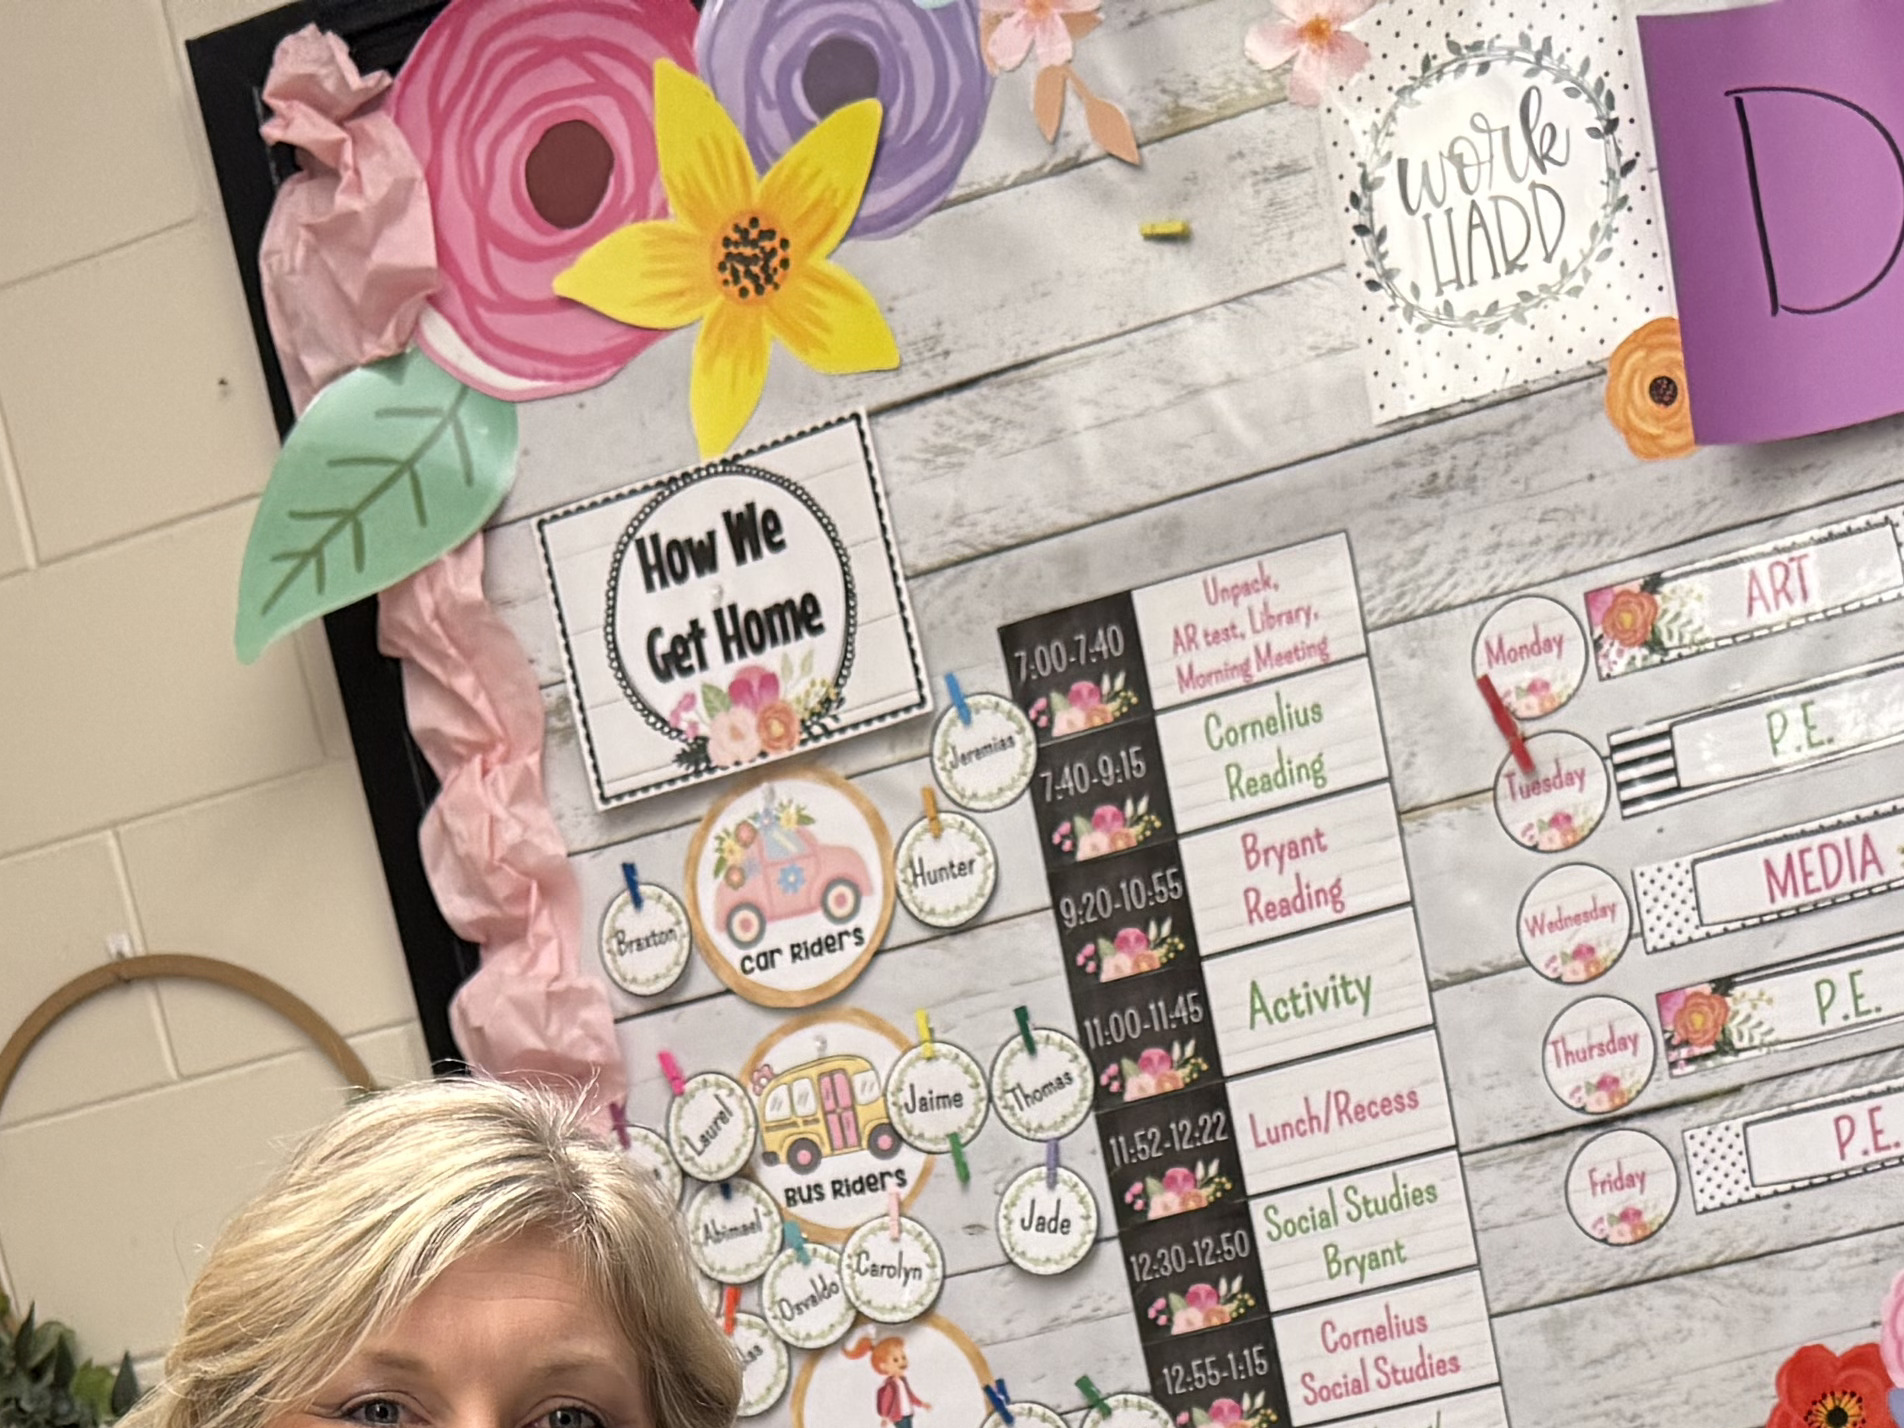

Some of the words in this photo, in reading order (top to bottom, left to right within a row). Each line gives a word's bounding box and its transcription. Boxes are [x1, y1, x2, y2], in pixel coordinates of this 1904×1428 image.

[1422, 180, 1566, 297] HARD
[635, 529, 718, 593] How
[722, 501, 787, 566] We
[1744, 553, 1812, 618] ART
[646, 619, 708, 685] Get
[713, 590, 826, 663] Home
[1014, 623, 1125, 682] 7:00-7:40
[1173, 622, 1198, 655] AR
[1176, 658, 1254, 693] Morning
[1254, 635, 1330, 672] Meeting
[1484, 622, 1564, 669] Monday
[1203, 690, 1324, 752] Cornelius
[1766, 700, 1836, 757] P.E.
[1039, 746, 1147, 803] 7:40-9:15
[1224, 751, 1327, 801] Reading
[1505, 764, 1586, 803] Tuesday
[911, 855, 977, 889] Hunter
[1241, 827, 1328, 873] Bryant
[1764, 830, 1885, 904] MEDIA
[1059, 868, 1184, 929] 9:20-10:55
[1243, 873, 1345, 926] Reading
[1523, 899, 1618, 938] Wednesday
[1083, 992, 1205, 1050] 11:00-11:45
[1248, 972, 1373, 1030] Activity
[1814, 969, 1882, 1027] P.E.
[1549, 1028, 1640, 1069] Thursday
[904, 1078, 963, 1115] Jaime
[1009, 1069, 1075, 1113] Thomas
[1249, 1087, 1426, 1149] Lunch/Recess
[1110, 1111, 1229, 1168] 11:52-12:22
[1833, 1105, 1901, 1161] P.E.
[1263, 1189, 1338, 1241] Social
[1344, 1171, 1439, 1222] Studies
[1588, 1165, 1648, 1203] Friday
[1020, 1199, 1071, 1237] Jade
[854, 1248, 922, 1287] Carolyn
[1129, 1229, 1251, 1284] 12:30-12:50
[1323, 1240, 1406, 1283] Bryant
[779, 1273, 840, 1322] Osvaldo
[1320, 1303, 1429, 1354] Cornelius
[1161, 1345, 1269, 1396] 12:55-1:15
[1301, 1357, 1370, 1405] Social
[1375, 1345, 1461, 1390] Studies
